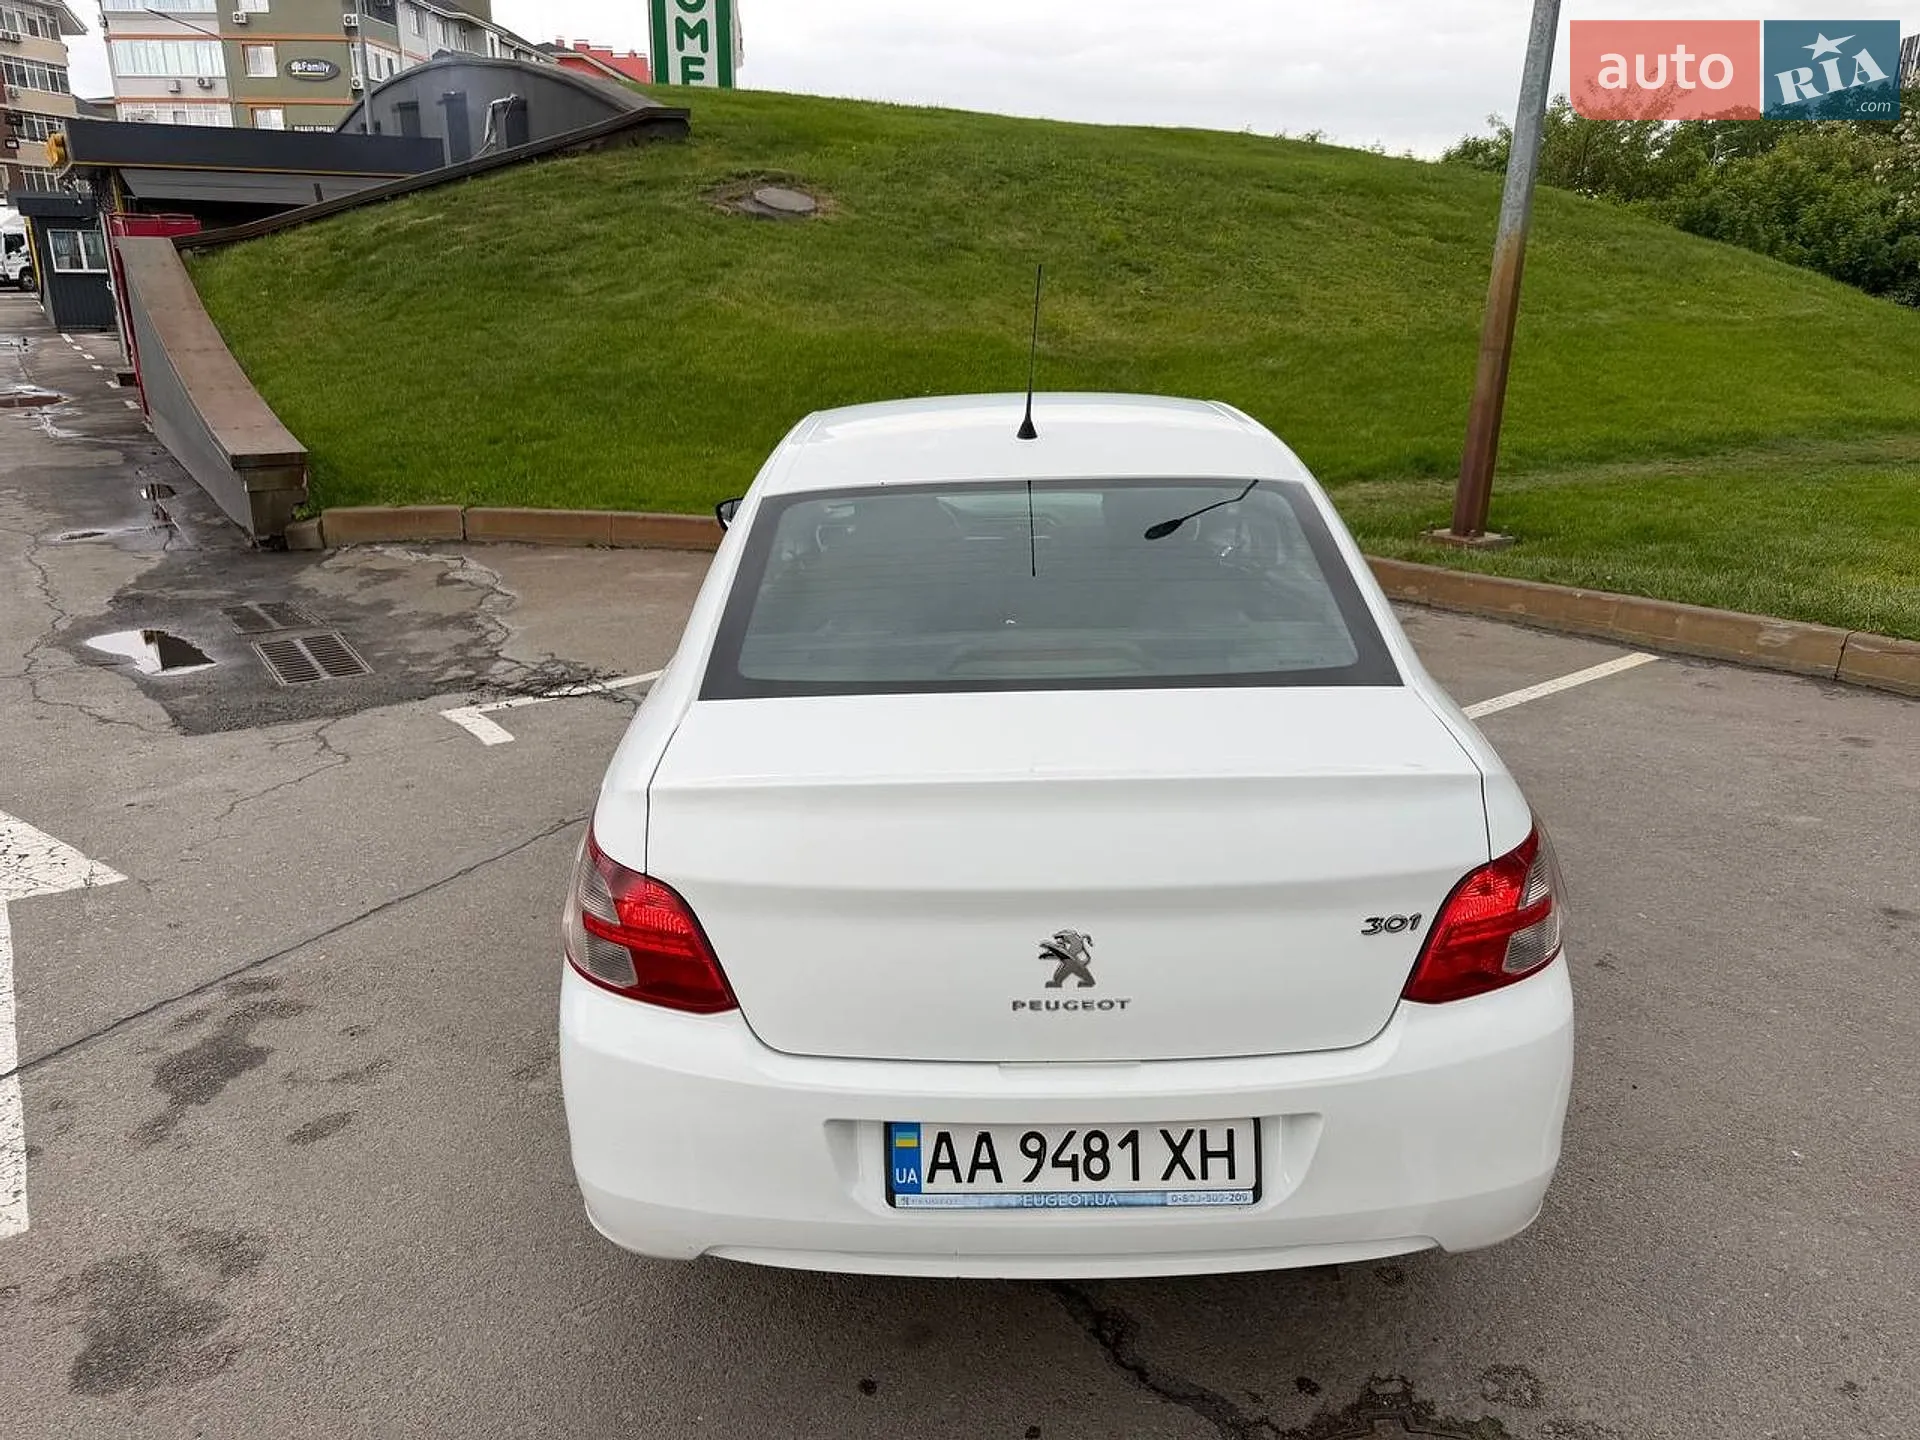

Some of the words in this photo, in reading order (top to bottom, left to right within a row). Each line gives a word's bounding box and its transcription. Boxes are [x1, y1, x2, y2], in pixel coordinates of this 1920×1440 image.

[1361, 913, 1422, 935] 301
[1011, 999, 1131, 1011] PEUGEOT
[926, 1131, 1004, 1184] AA
[1019, 1129, 1141, 1183] 9481
[1160, 1128, 1236, 1181] XH
[895, 1167, 918, 1184] UA
